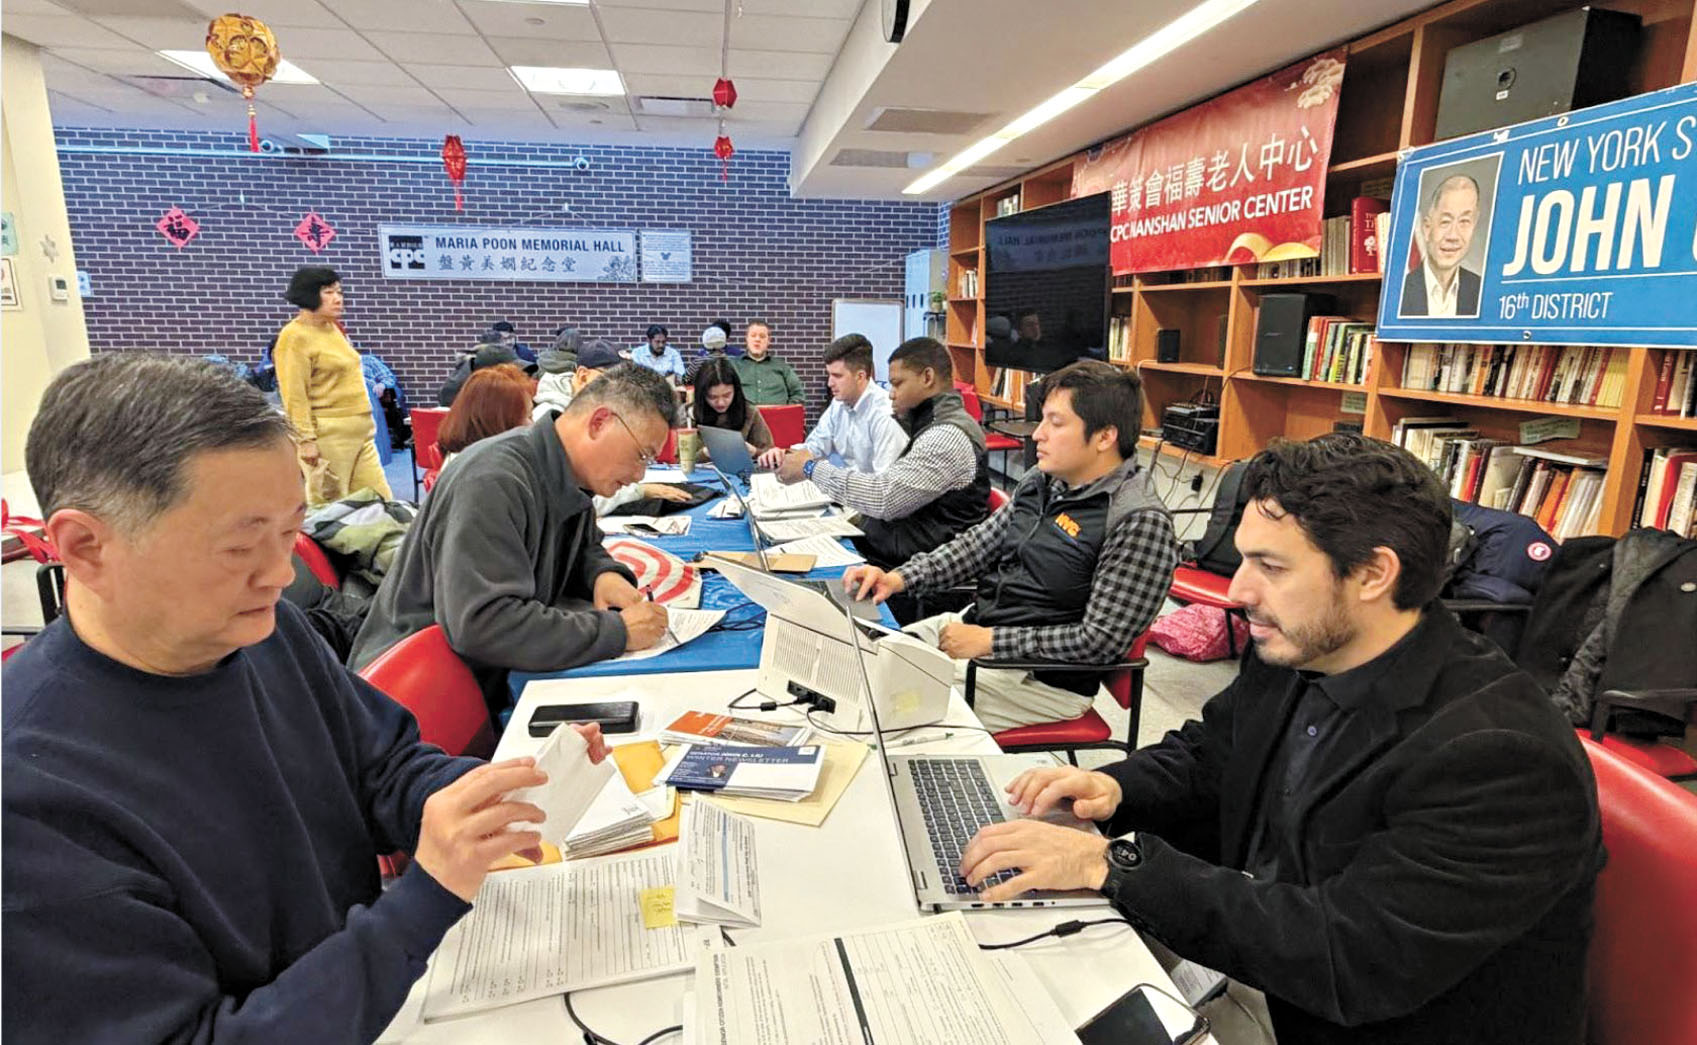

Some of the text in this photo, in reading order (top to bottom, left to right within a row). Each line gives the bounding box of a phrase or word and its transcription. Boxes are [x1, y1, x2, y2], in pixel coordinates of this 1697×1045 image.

[1518, 115, 1696, 185] NEW YORK S
[1187, 200, 1241, 230] SENIOR
[1243, 185, 1314, 219] CENTER
[1502, 174, 1676, 276] JOHN
[435, 236, 478, 250] MARIA
[483, 238, 517, 250] POON
[521, 239, 589, 252] MEMORIAL
[593, 240, 625, 252] HALL
[1499, 292, 1613, 320] 16th DISTRICT
